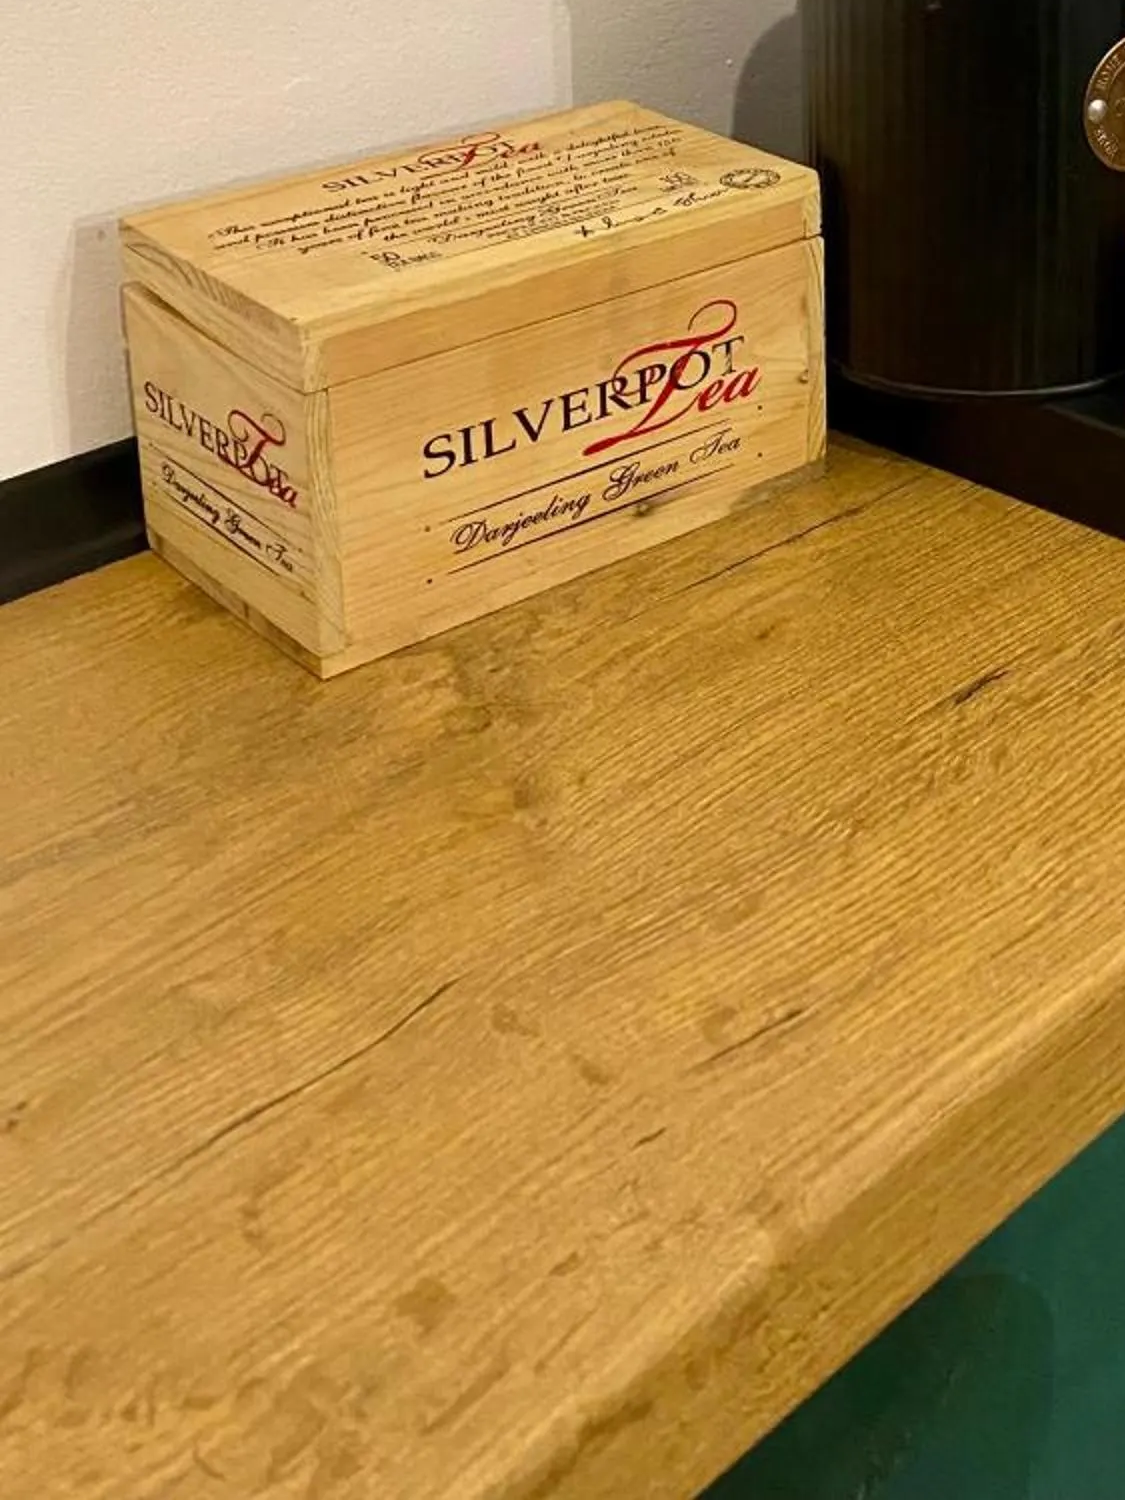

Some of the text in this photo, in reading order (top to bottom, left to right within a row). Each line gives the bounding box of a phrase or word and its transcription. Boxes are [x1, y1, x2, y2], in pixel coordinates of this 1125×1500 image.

[143, 381, 288, 489] SILVERPOT
[423, 299, 761, 479] SILVERPOT Tea
[452, 427, 741, 555] Darjeeling Green Tea
